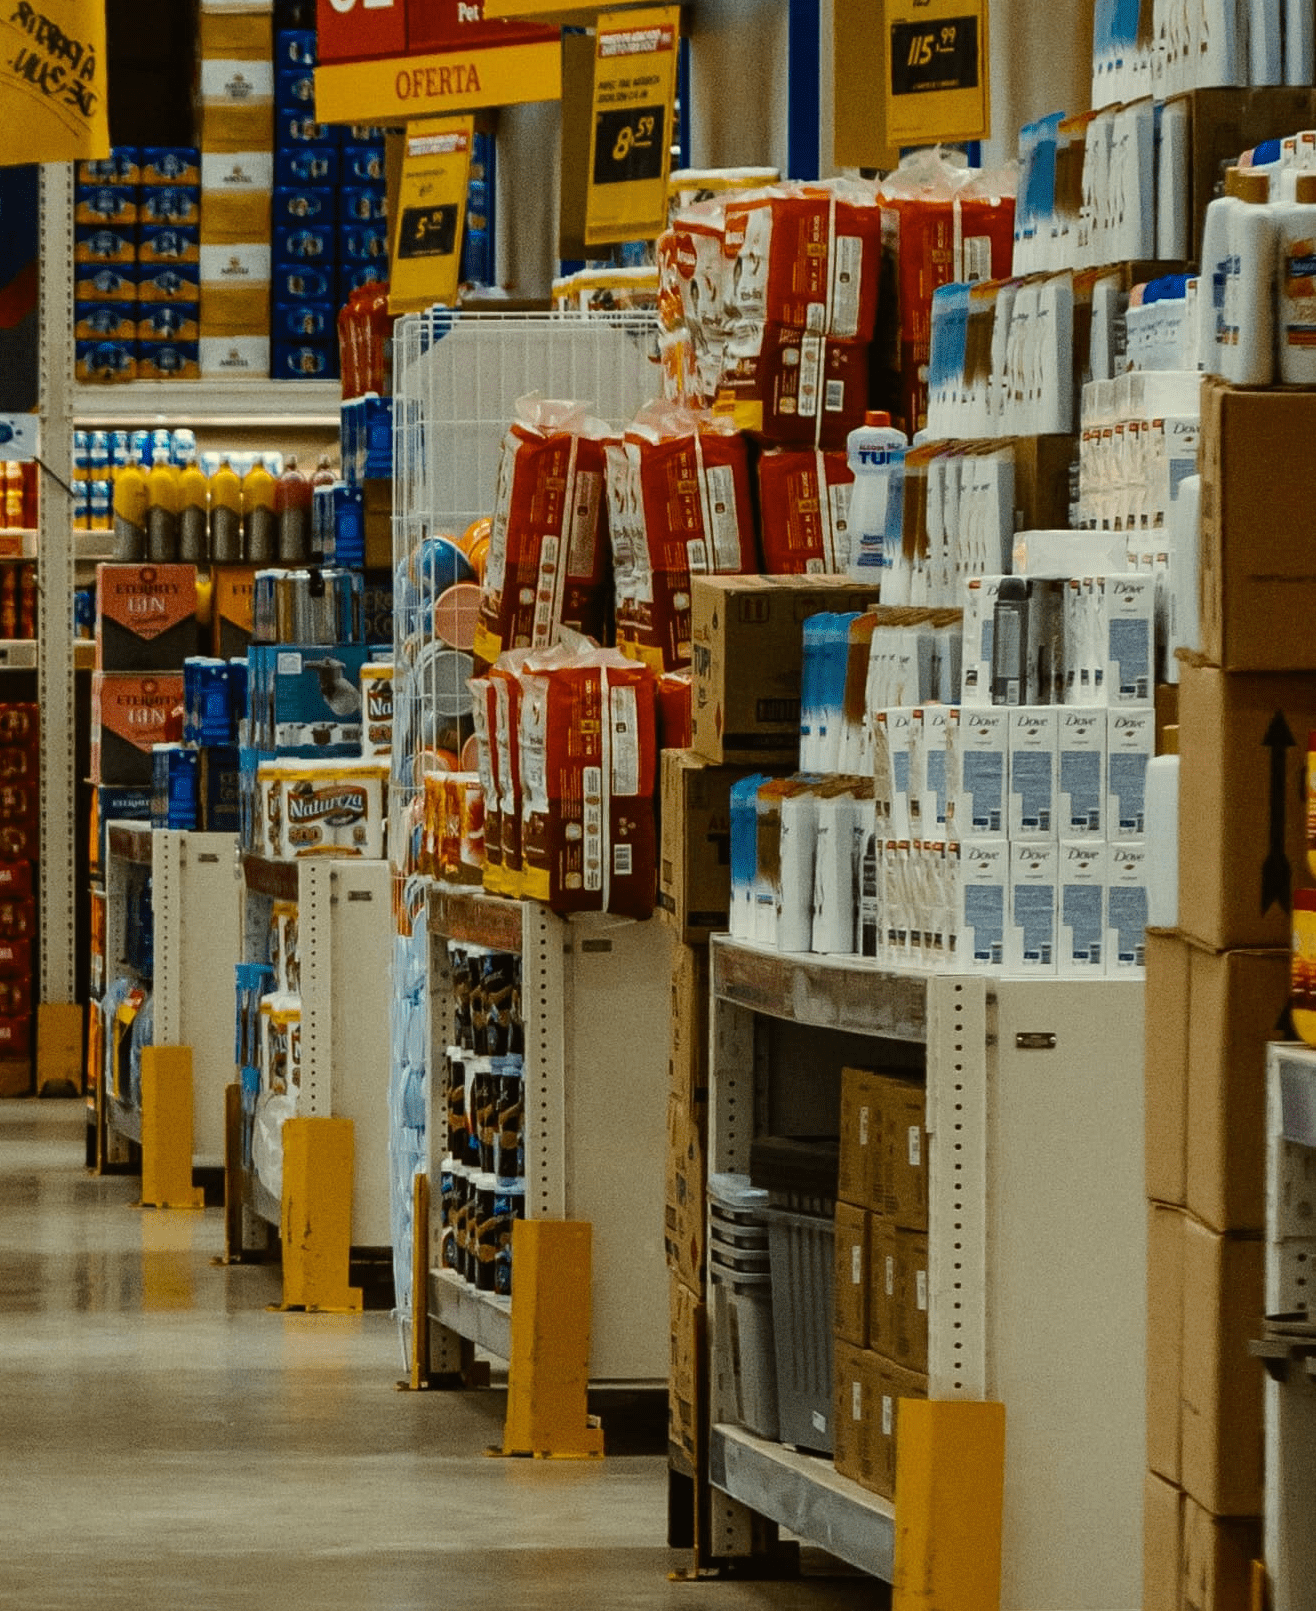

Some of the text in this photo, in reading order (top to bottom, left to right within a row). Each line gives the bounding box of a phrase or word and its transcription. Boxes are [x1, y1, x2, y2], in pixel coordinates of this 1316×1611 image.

[458, 2, 479, 23] Pet
[396, 65, 481, 99] OFERTA
[1113, 583, 1144, 595] Dove
[969, 715, 1000, 727] Dove
[290, 790, 363, 814] Natureza
